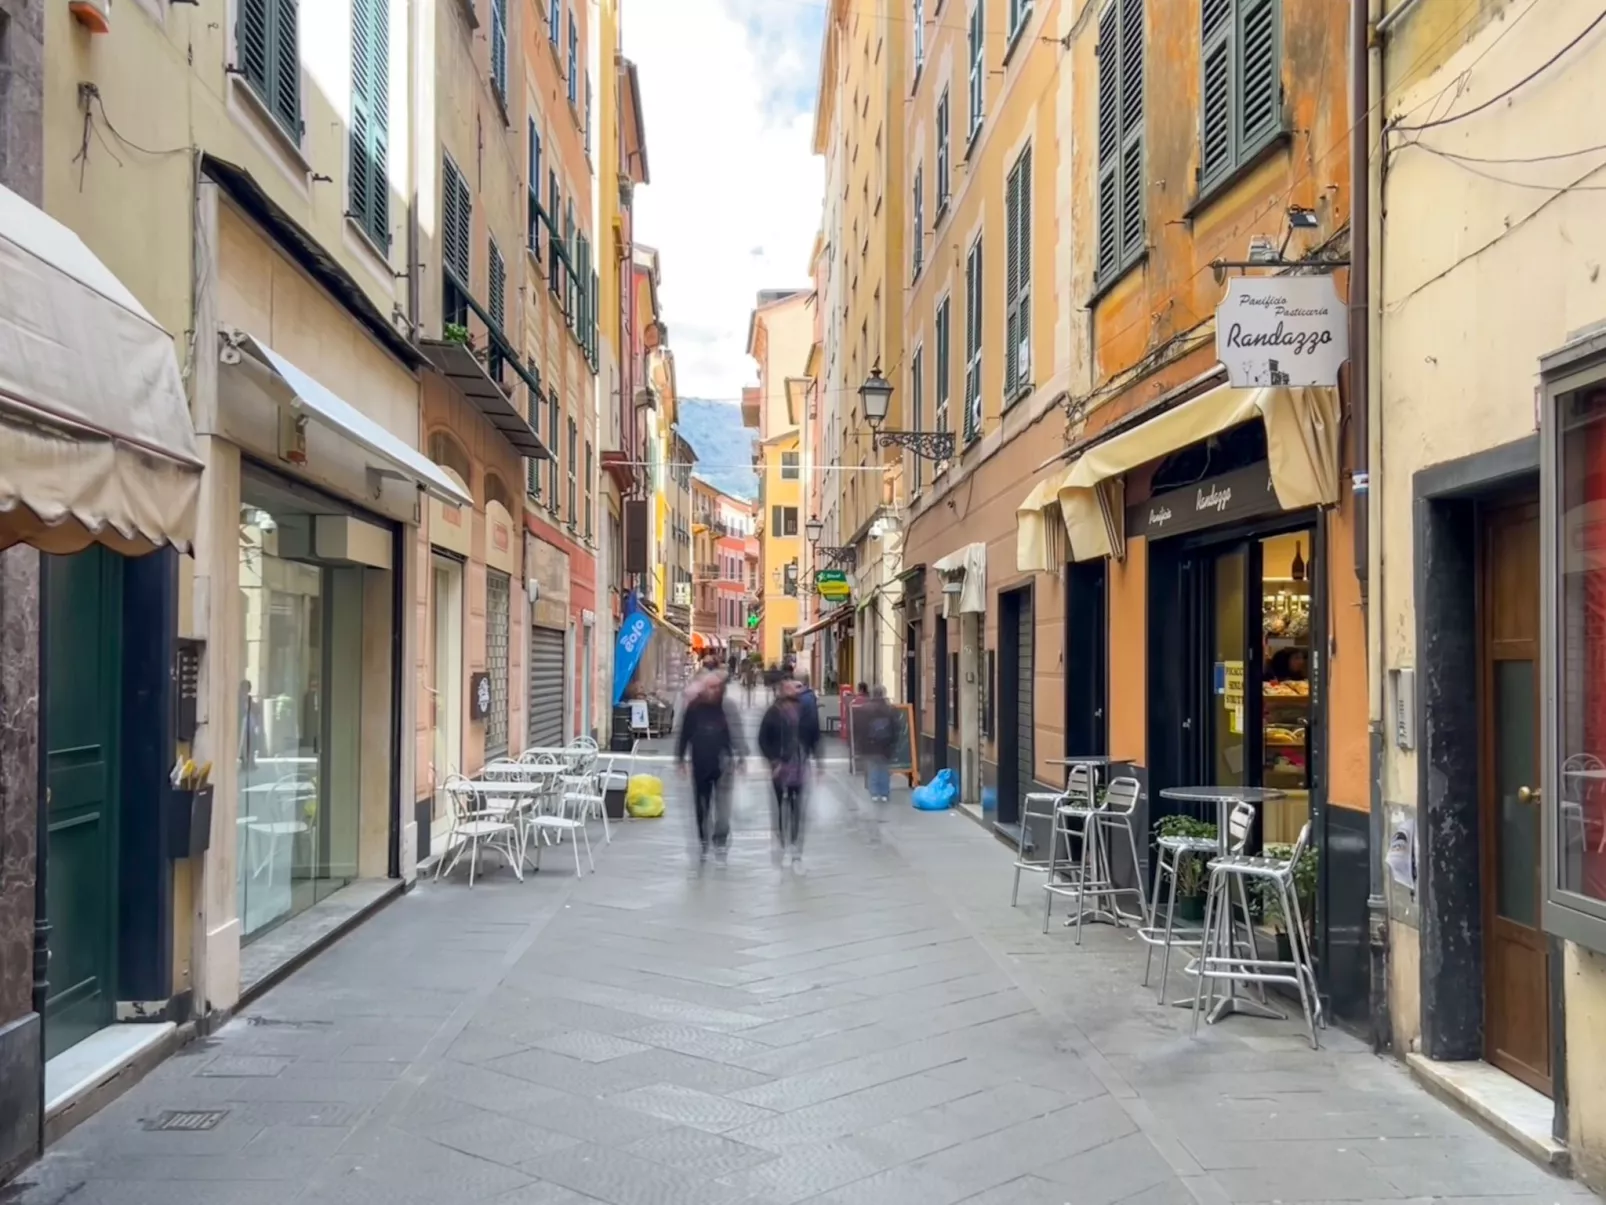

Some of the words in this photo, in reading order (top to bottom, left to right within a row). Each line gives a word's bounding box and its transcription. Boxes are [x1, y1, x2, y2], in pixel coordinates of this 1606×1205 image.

[1239, 294, 1287, 308] Panificio
[1274, 306, 1329, 317] Pasticceria
[1227, 321, 1332, 355] Randazzo
